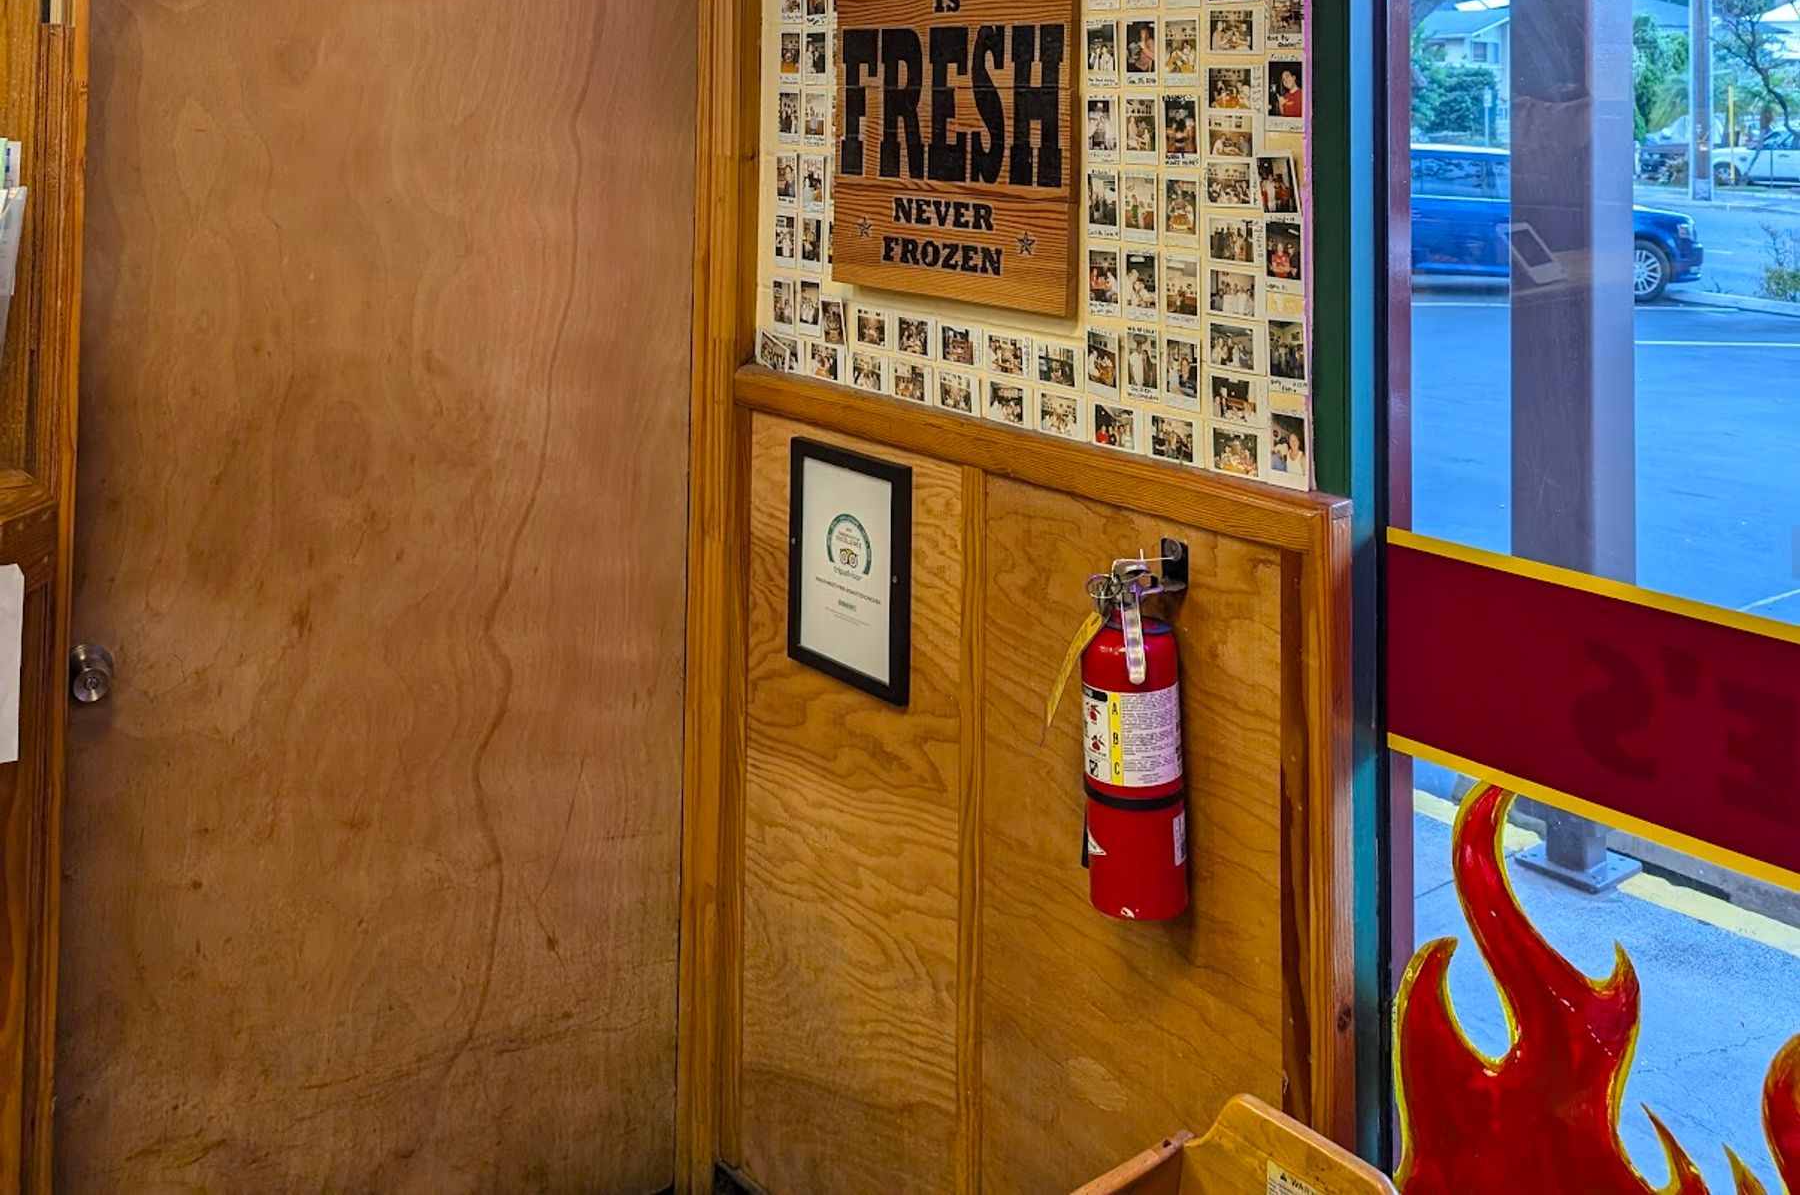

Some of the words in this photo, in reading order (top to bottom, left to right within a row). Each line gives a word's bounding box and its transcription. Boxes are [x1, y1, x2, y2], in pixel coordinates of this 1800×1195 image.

[841, 24, 1065, 188] FRESH
[893, 197, 995, 232] NEVER
[881, 236, 1003, 276] FROZEN
[1111, 702, 1118, 716] A
[1112, 731, 1119, 746] B
[1113, 761, 1120, 775] C
